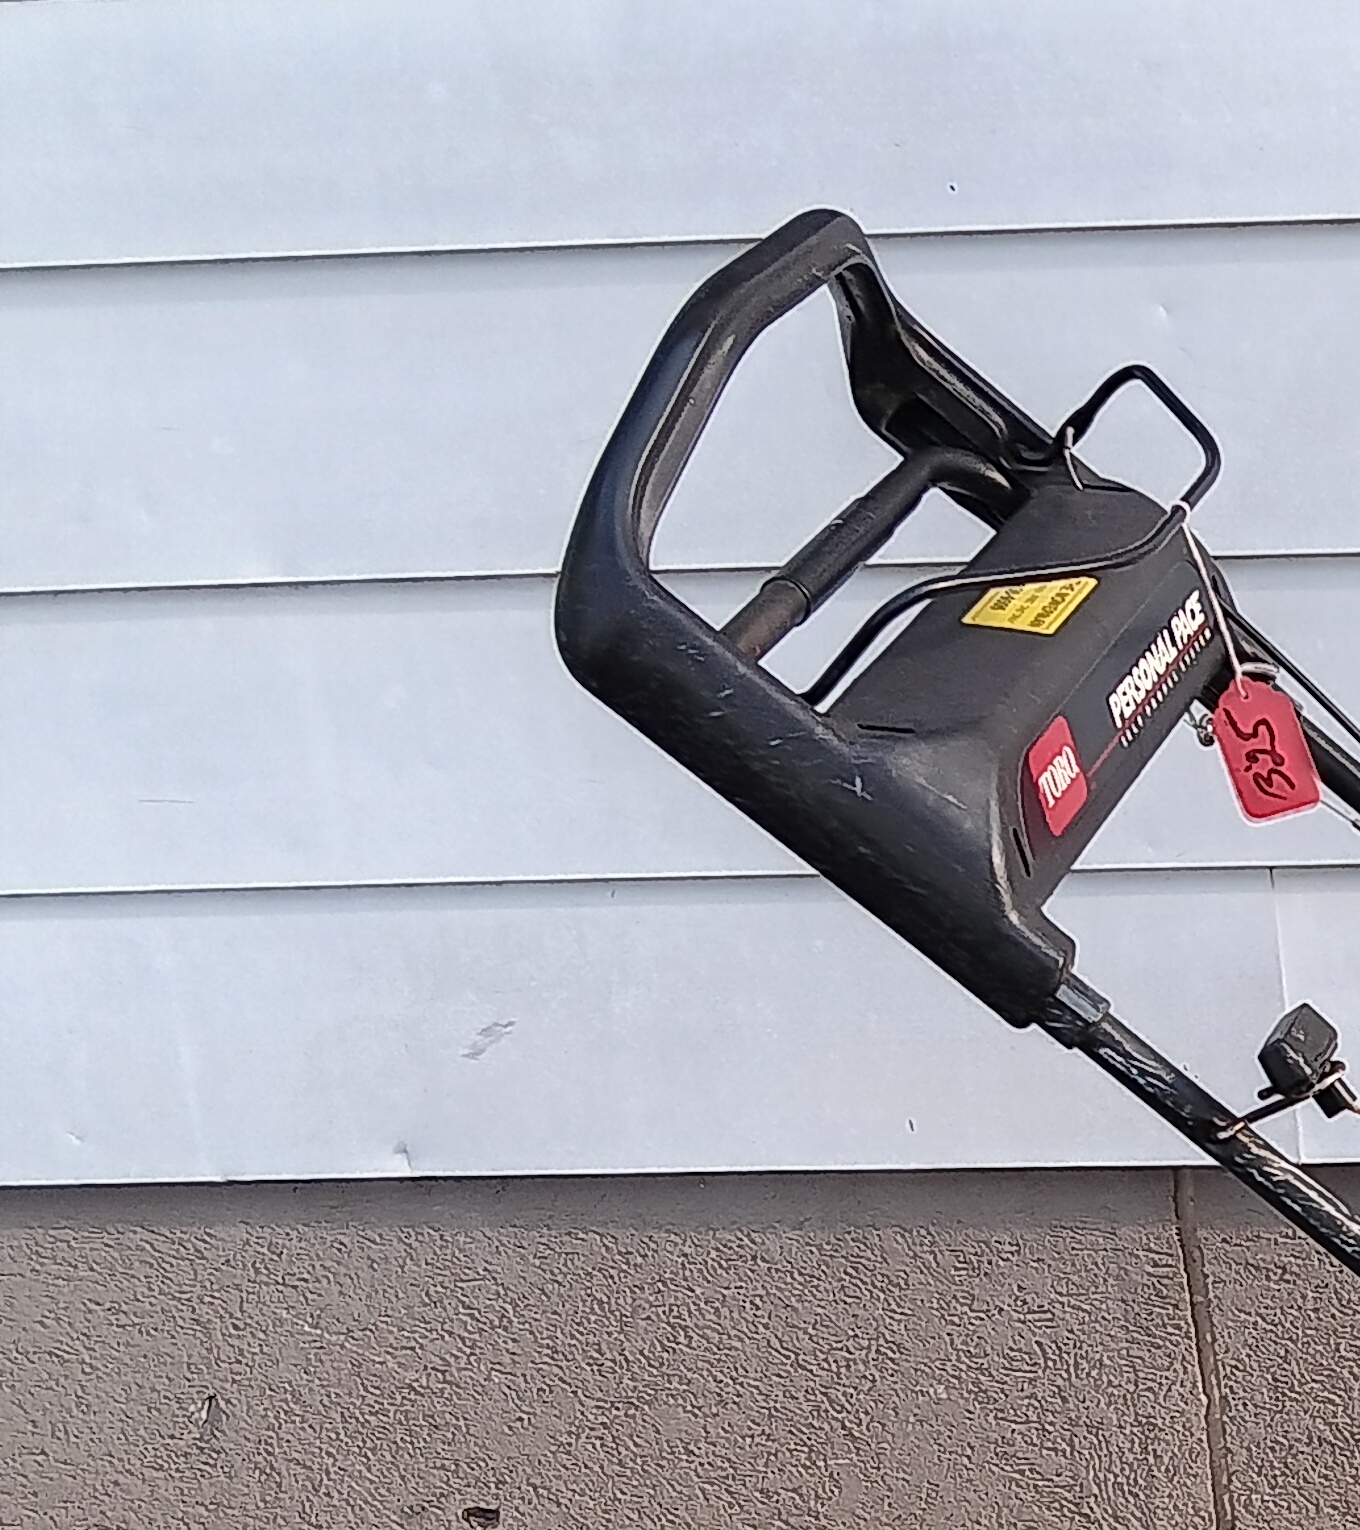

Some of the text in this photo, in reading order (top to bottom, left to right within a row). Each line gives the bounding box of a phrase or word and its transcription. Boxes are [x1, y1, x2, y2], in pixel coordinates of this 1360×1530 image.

[1109, 628, 1178, 729] PERSONAL
[1170, 589, 1205, 651] PACE
[1038, 745, 1080, 808] TORO
